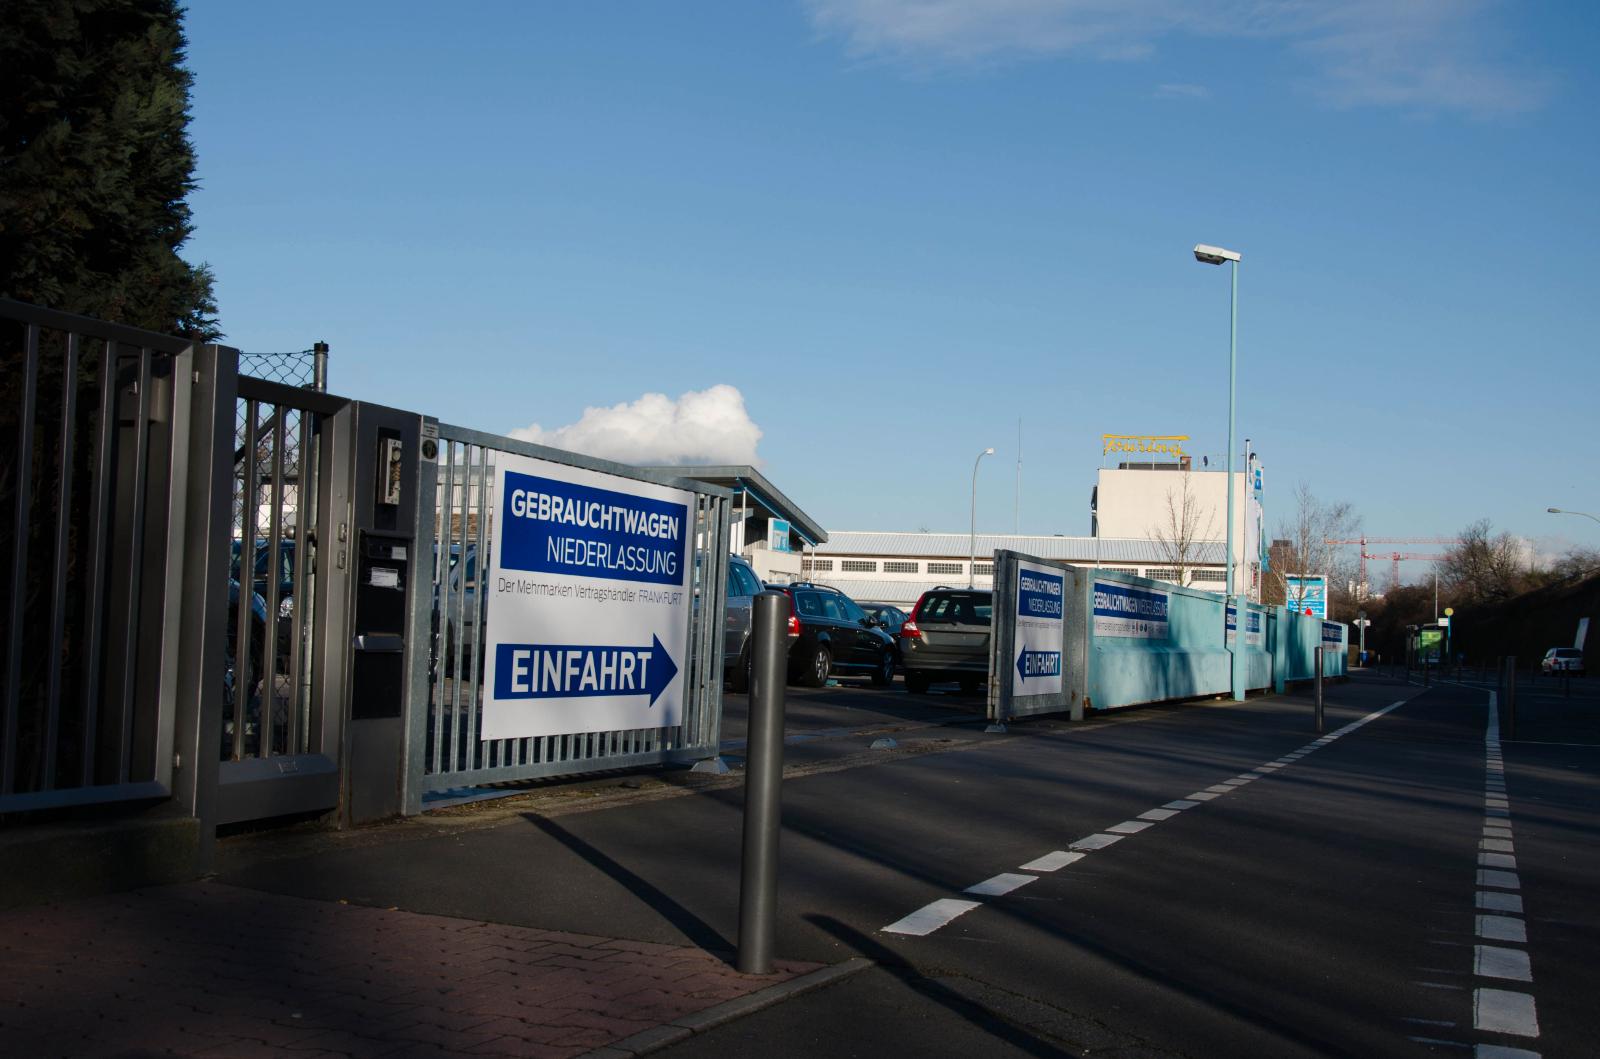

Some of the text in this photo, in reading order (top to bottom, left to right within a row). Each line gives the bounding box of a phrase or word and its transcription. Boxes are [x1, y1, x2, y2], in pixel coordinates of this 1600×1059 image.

[511, 488, 679, 541] GEBRAUCHTWAGEN
[547, 535, 676, 576] NIEDERLASSUNG
[498, 577, 516, 594] Der
[517, 579, 572, 598] Mehrmarken
[638, 589, 683, 606] FRANKFURT
[1021, 577, 1061, 596] GEBRAUCHTWAGEN
[1029, 597, 1061, 615] NIEDERLASSUNG
[1094, 591, 1138, 613] GEBRAUCHTWAGEN
[511, 649, 652, 693] EINFAHRT
[1025, 651, 1059, 675] EINFAHRT
